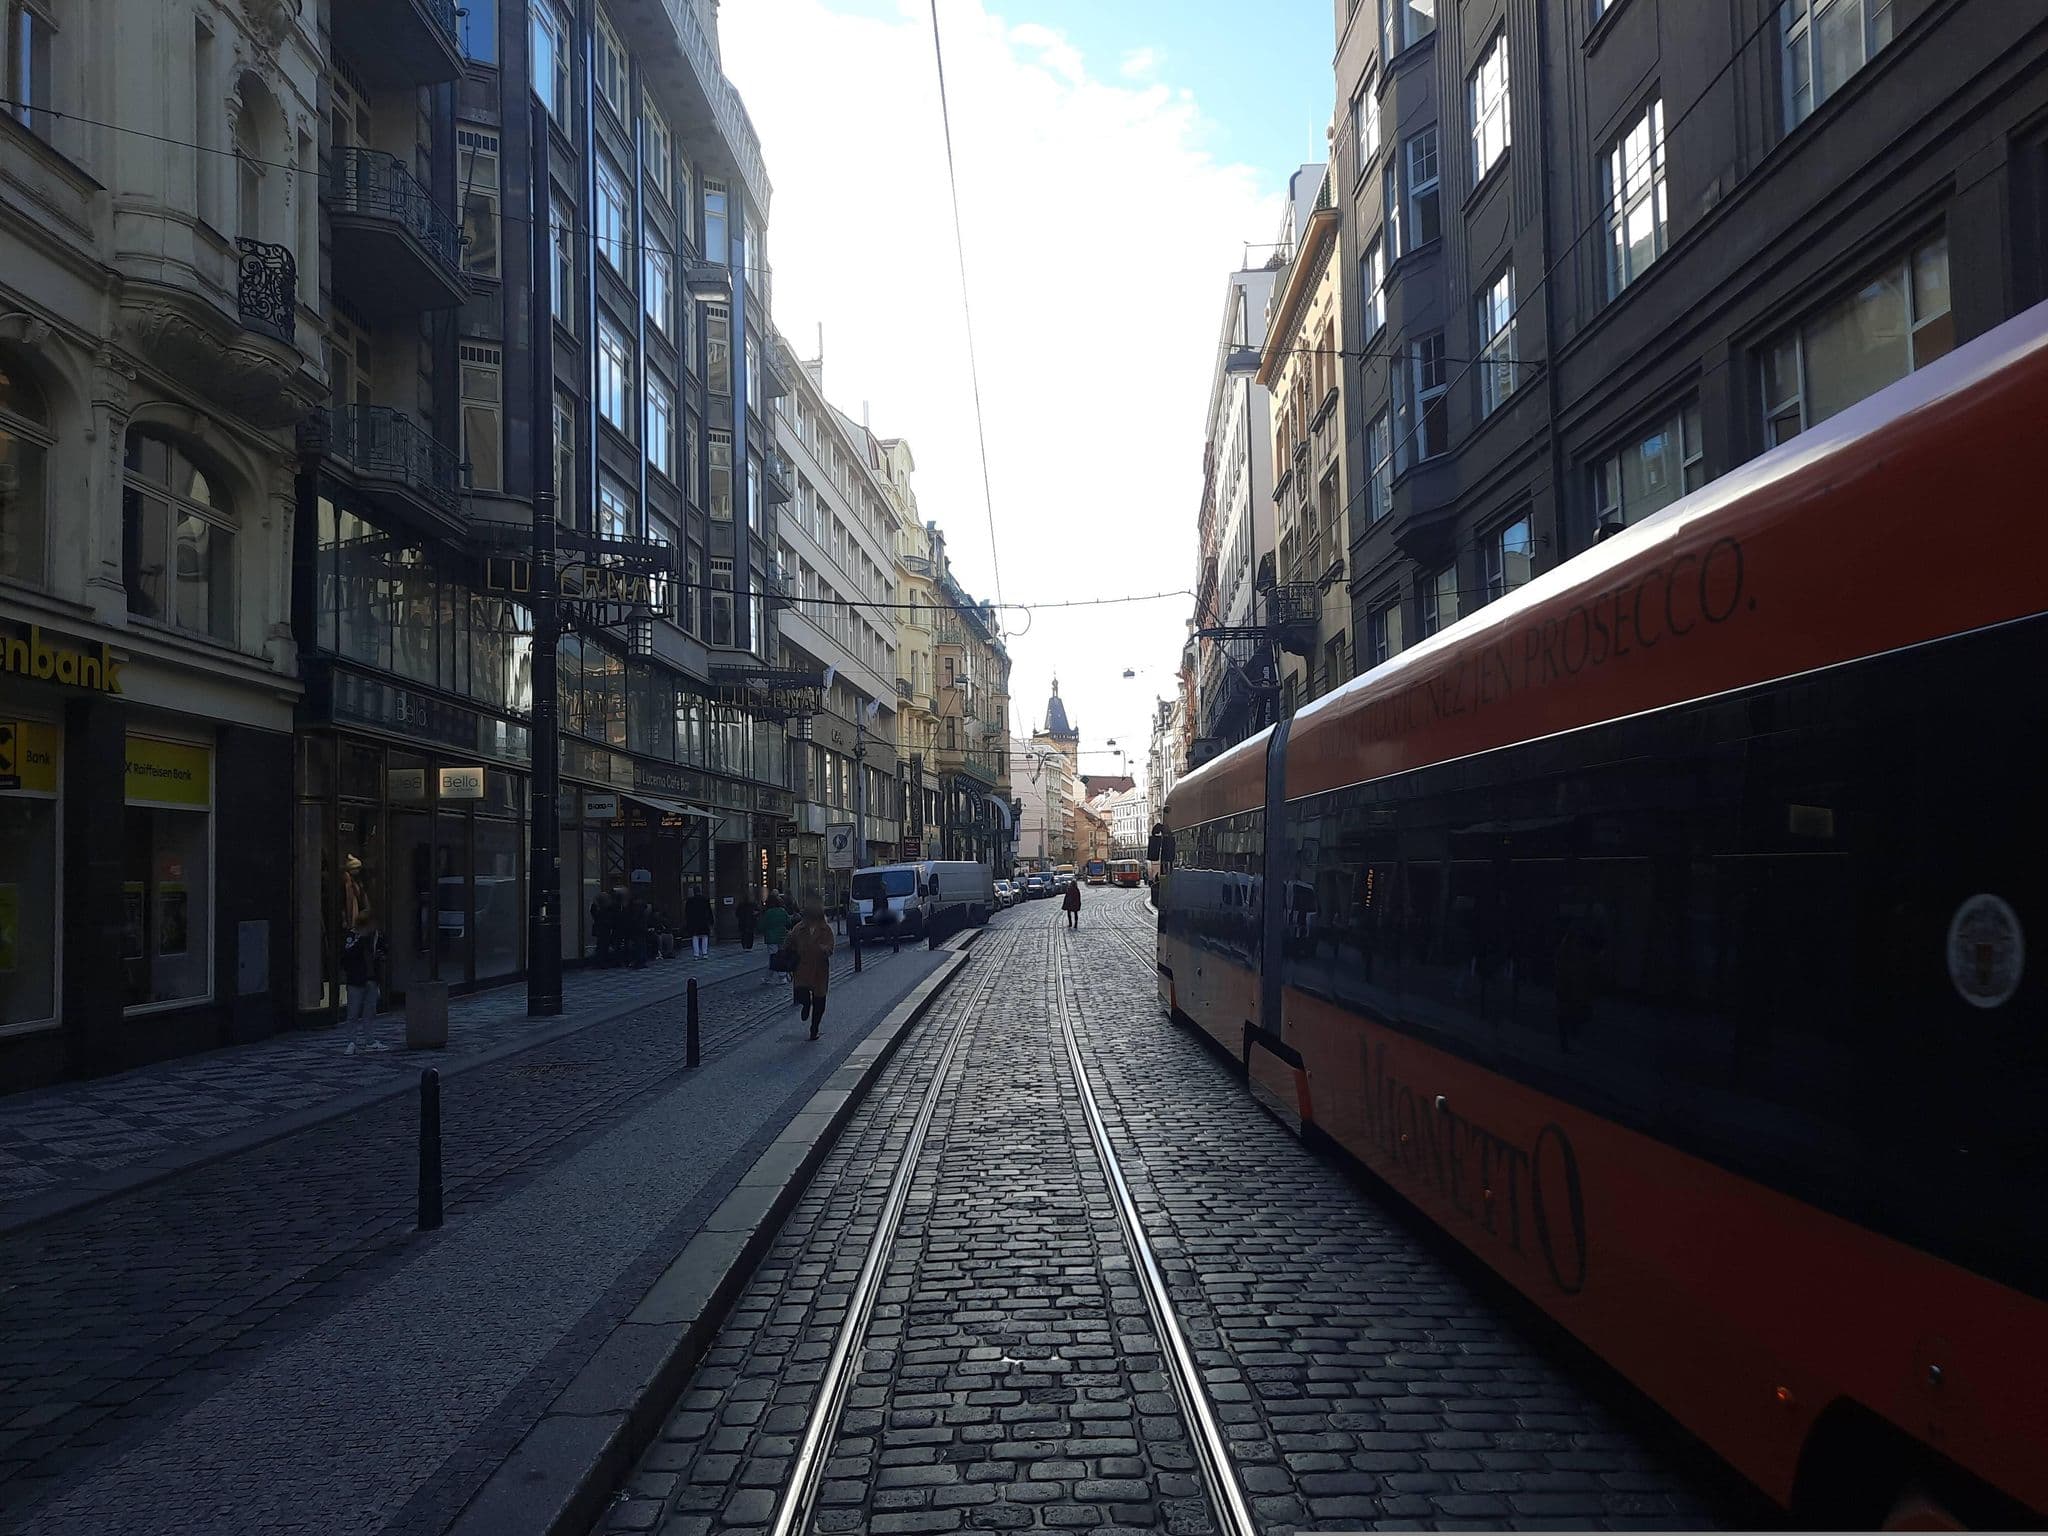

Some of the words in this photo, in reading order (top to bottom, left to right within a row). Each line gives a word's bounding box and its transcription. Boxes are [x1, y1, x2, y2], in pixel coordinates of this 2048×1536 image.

[486, 557, 651, 604] LUERNA
[1525, 537, 1756, 688] PROSECCO.
[26, 750, 51, 766] Bank
